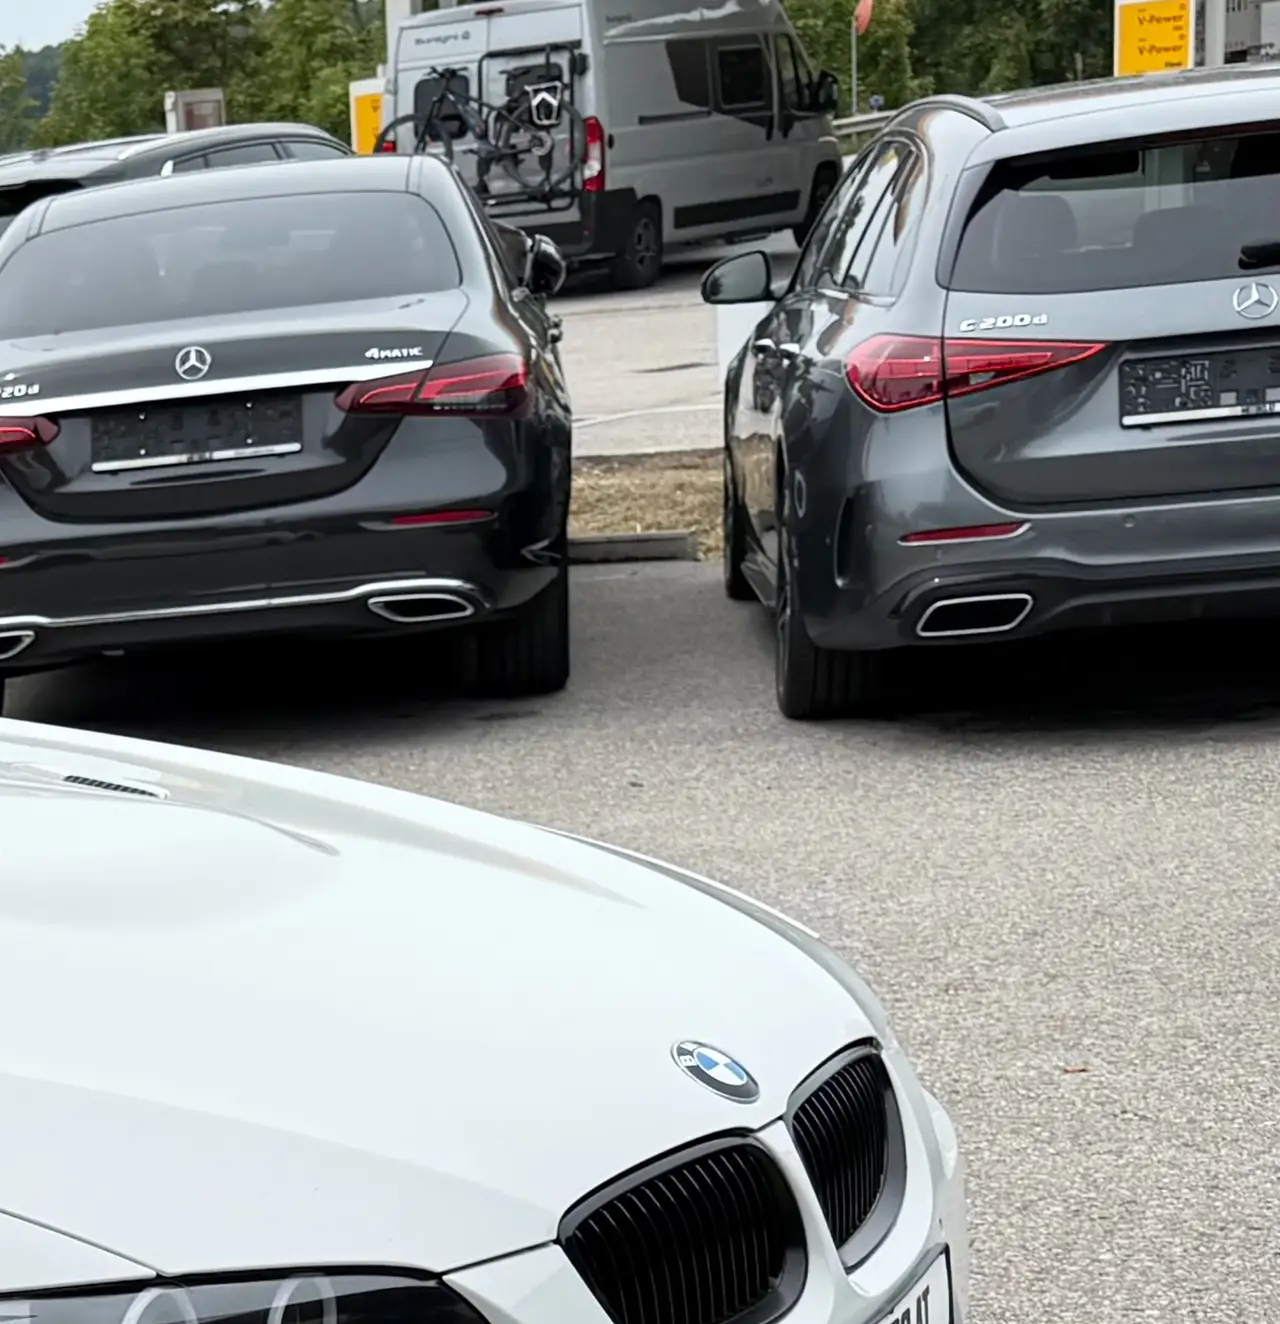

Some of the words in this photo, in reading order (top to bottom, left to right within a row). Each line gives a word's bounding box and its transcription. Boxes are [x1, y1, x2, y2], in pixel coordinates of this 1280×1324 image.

[960, 319, 976, 332] C
[978, 313, 1048, 330] 200d
[364, 346, 423, 360] 4MATIC
